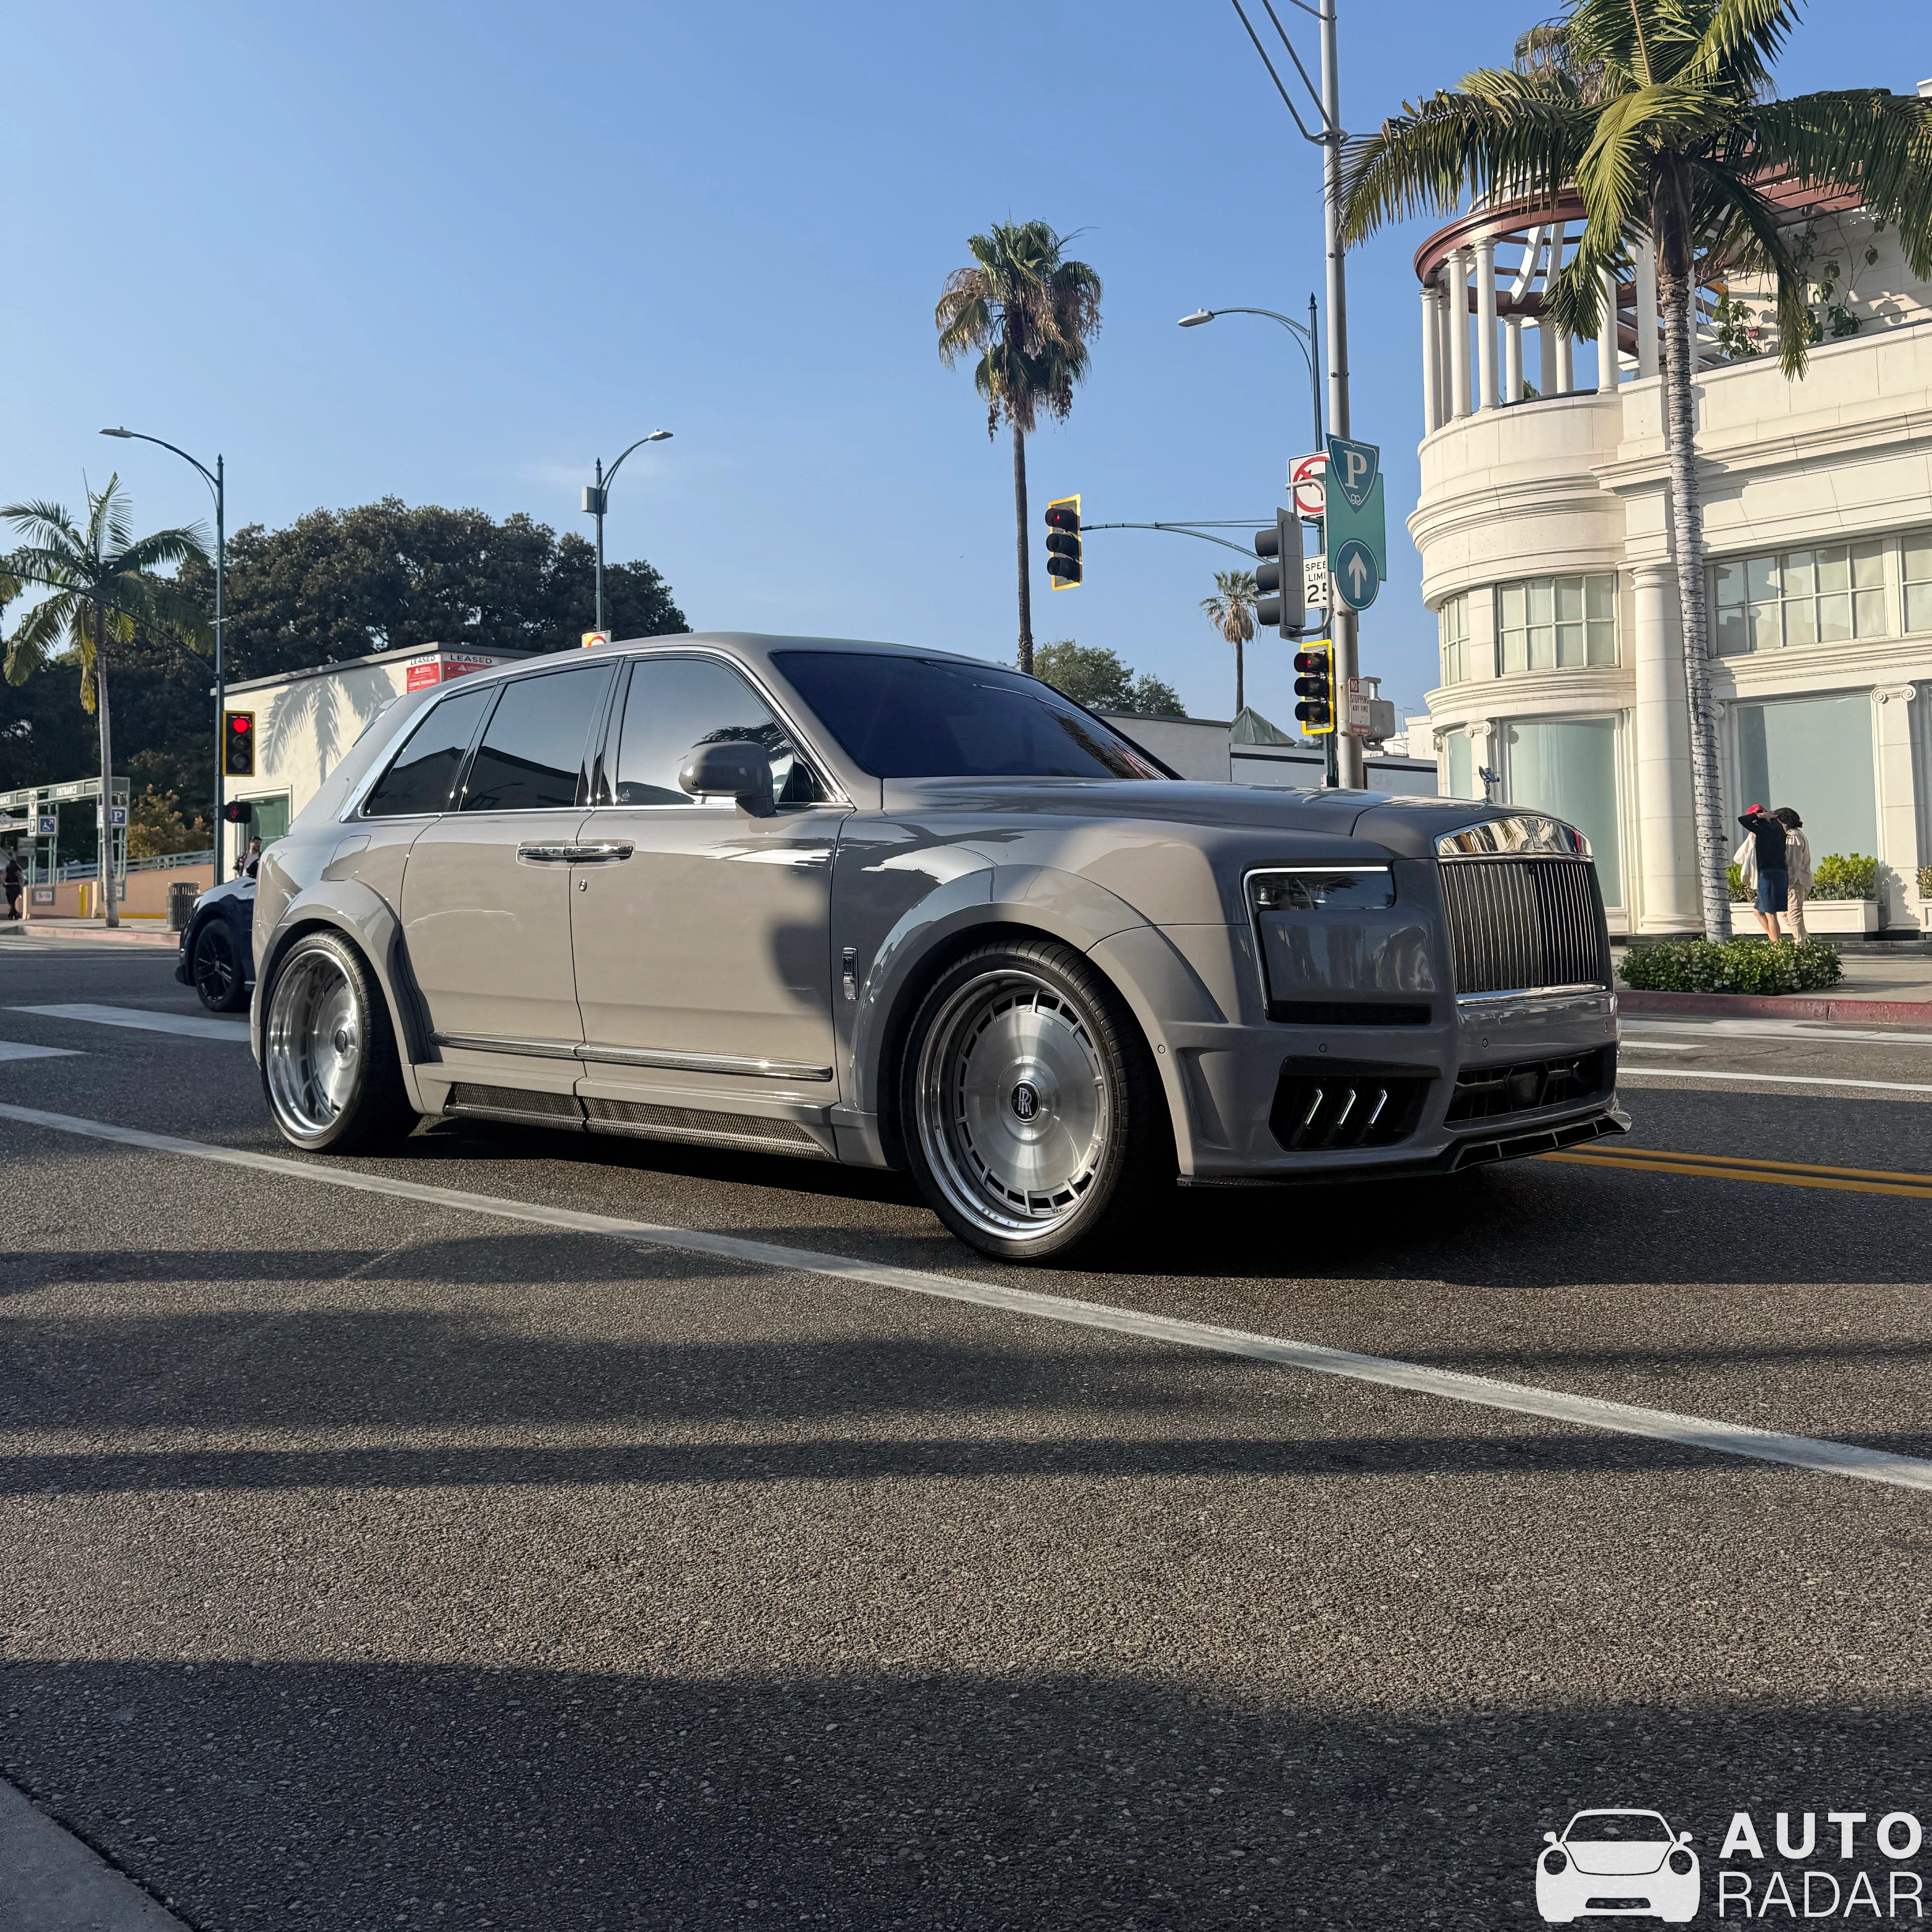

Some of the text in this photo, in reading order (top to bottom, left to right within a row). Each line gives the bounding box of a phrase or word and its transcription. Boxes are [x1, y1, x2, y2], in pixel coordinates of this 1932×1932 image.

[1343, 450, 1367, 489] P
[1305, 561, 1326, 571] SPEE
[1308, 572, 1326, 581] LIMI
[411, 655, 436, 665] LEASED
[451, 654, 492, 664] LEASED
[1351, 679, 1358, 691] NO
[56, 785, 77, 796] ENTRANCE
[113, 811, 123, 822] P
